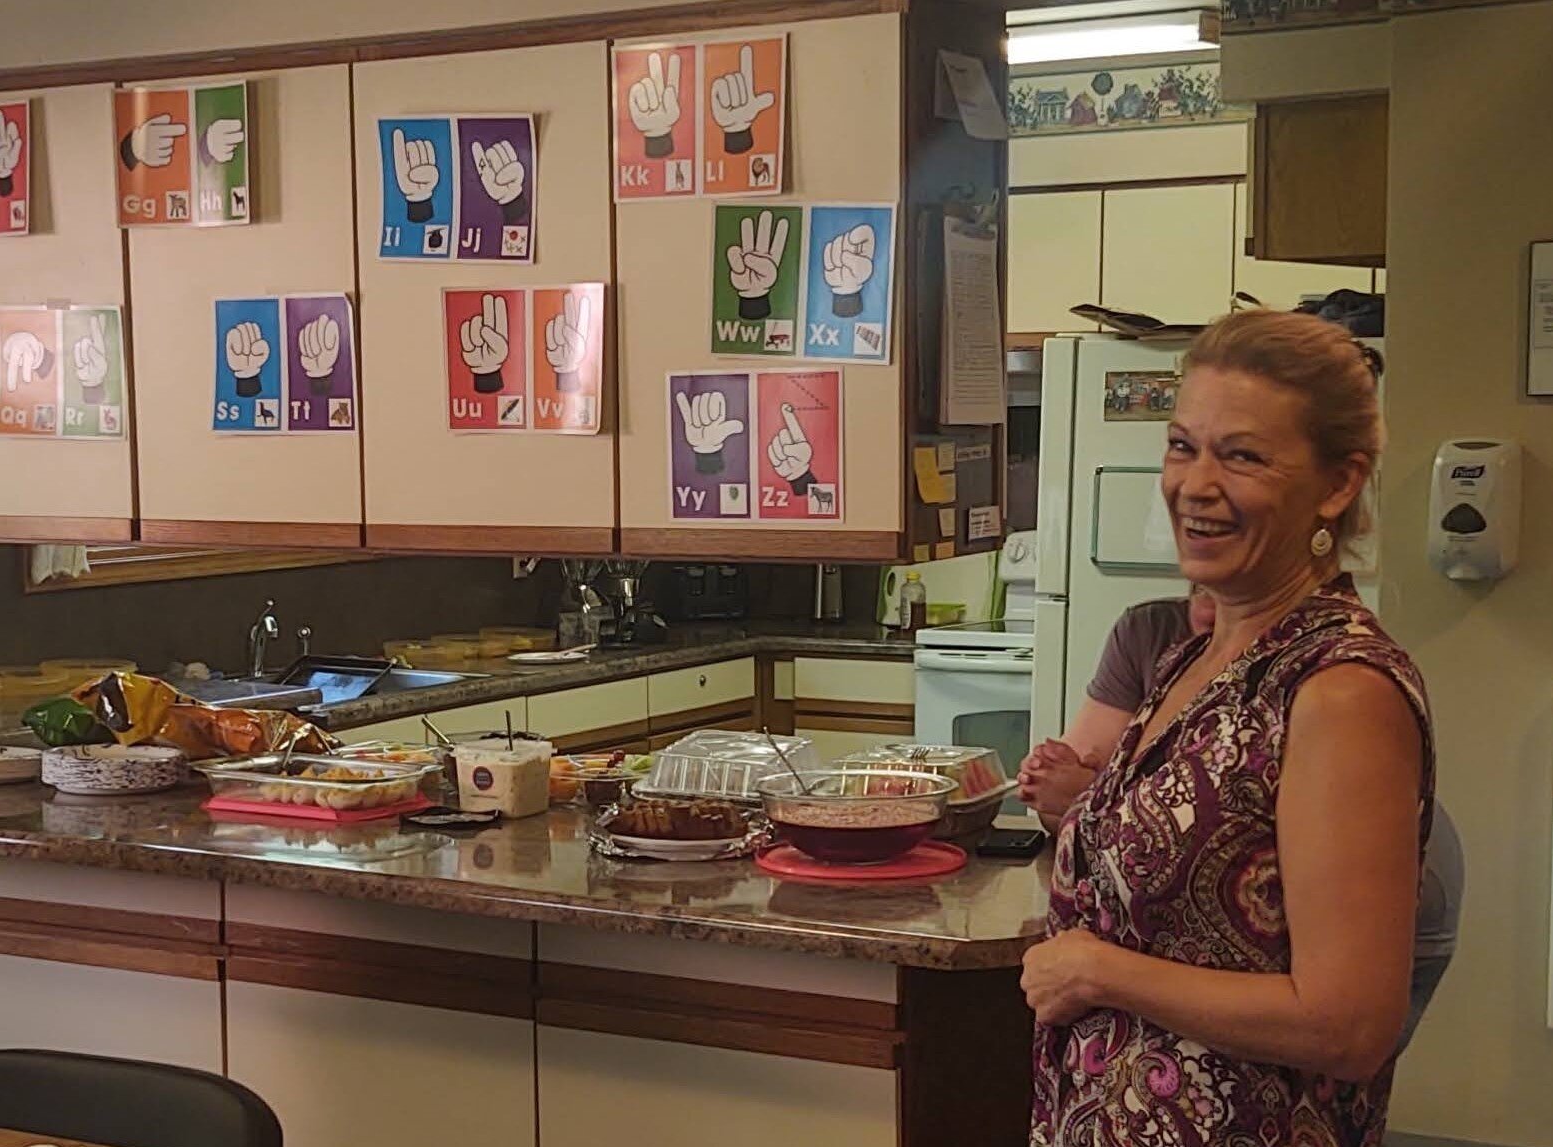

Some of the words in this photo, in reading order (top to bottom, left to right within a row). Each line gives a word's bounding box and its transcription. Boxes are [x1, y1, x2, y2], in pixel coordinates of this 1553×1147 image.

[620, 165, 649, 187] Kk
[706, 160, 725, 182] Ll
[123, 194, 156, 219] Gg
[200, 189, 223, 212] Hh
[383, 226, 401, 247] Ii
[461, 227, 482, 253] Jj
[716, 320, 761, 343] Ww
[809, 323, 840, 346] Xx
[1, 406, 27, 428] Qq
[66, 407, 85, 425] Rr
[216, 401, 240, 421] Ss
[291, 400, 311, 420] Tt
[452, 398, 482, 418] Uu
[536, 398, 564, 419] Vv
[676, 486, 706, 512] Yy
[761, 486, 789, 507] Zz
